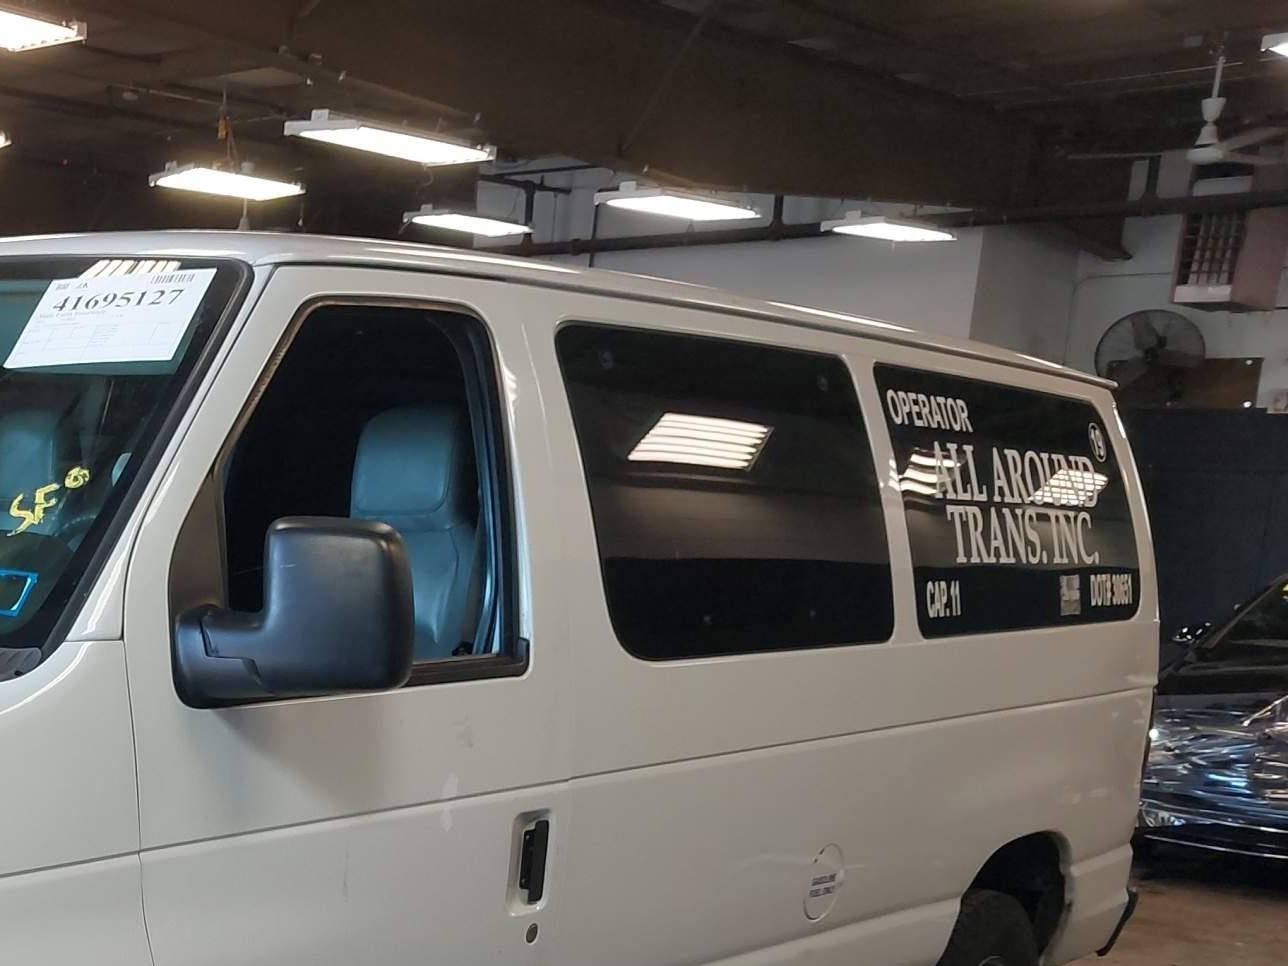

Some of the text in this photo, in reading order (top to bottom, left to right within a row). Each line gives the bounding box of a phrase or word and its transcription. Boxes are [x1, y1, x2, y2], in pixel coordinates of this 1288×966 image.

[52, 289, 184, 312] 41695127
[886, 389, 973, 432] OPERATOR
[933, 441, 1100, 507] ALL AROUND
[946, 505, 1100, 564] TRANS. INC.
